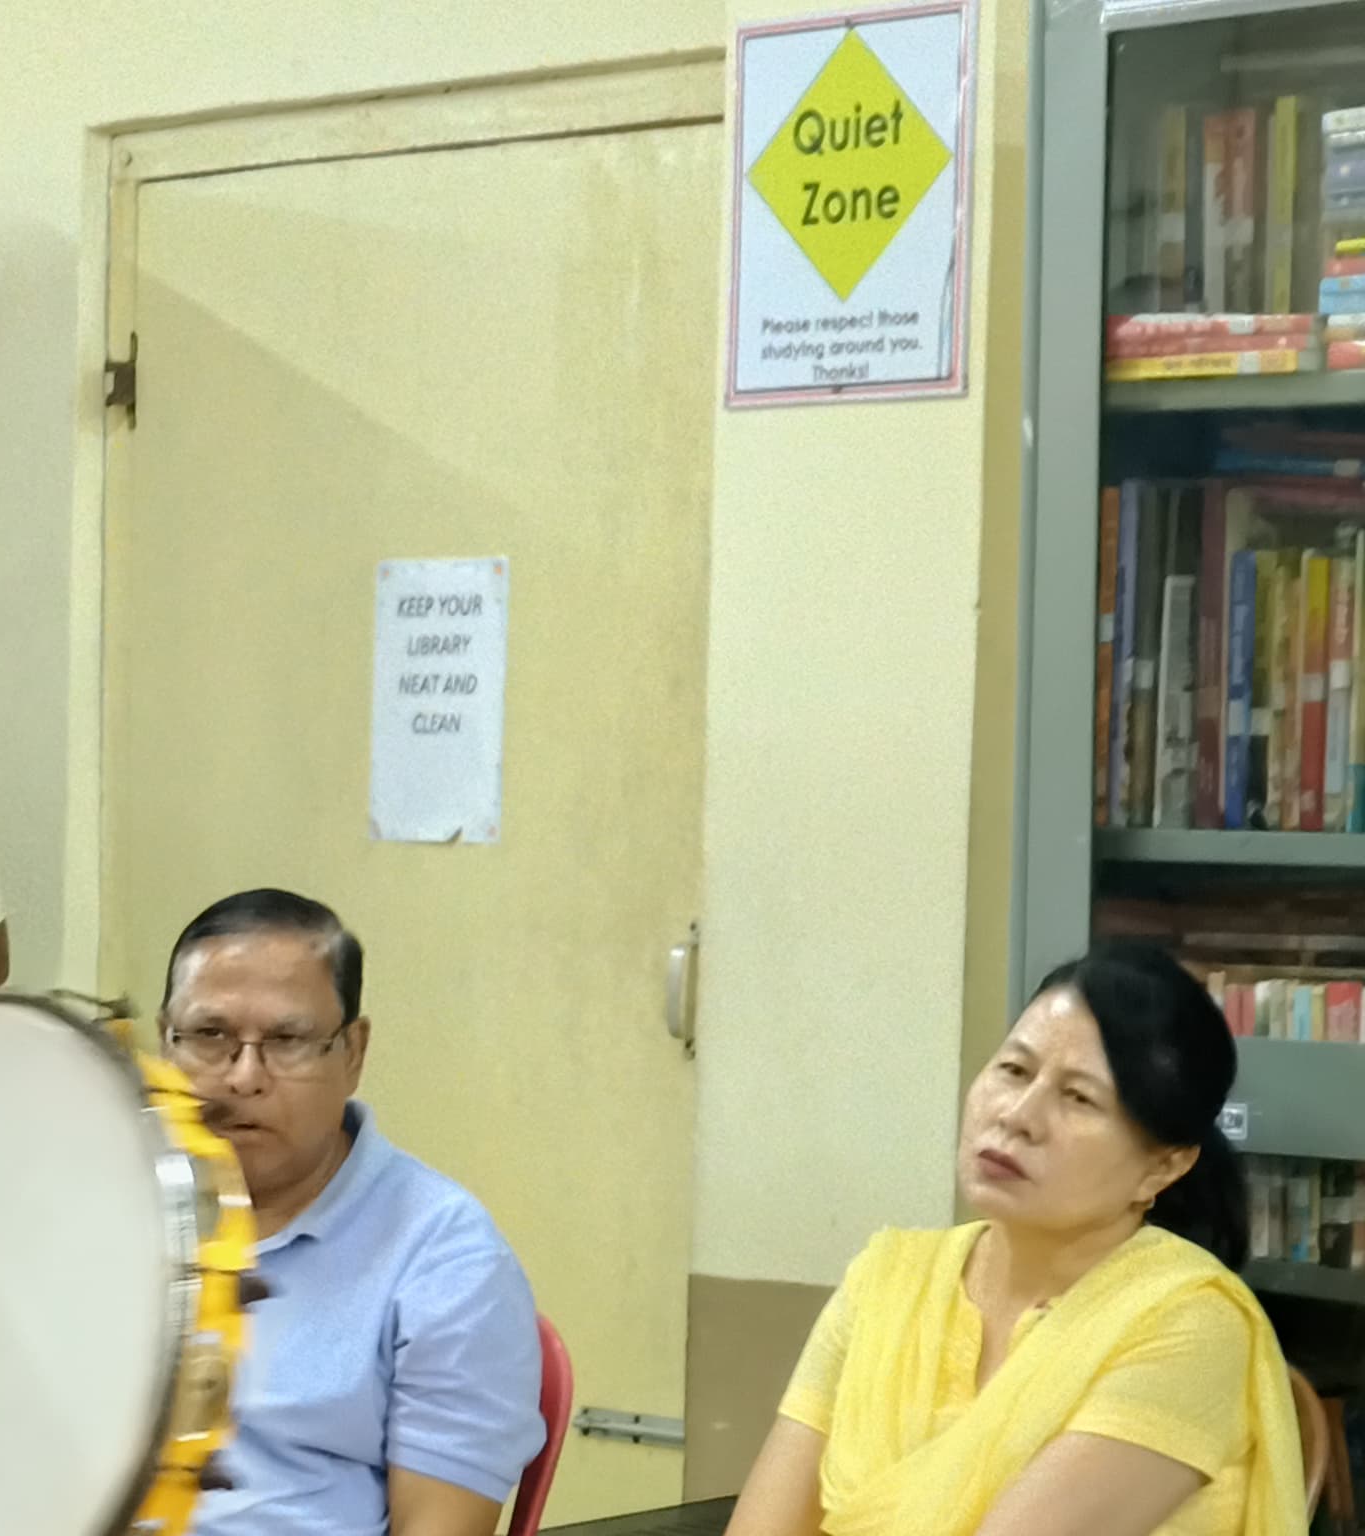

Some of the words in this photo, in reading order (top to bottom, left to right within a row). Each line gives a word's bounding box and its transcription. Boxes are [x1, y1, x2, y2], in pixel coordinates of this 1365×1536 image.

[793, 98, 903, 156] Quiet
[801, 181, 900, 226] Zone
[761, 317, 811, 335] Please
[815, 310, 874, 332] respect
[877, 308, 920, 327] those
[761, 340, 825, 361] studying
[828, 336, 885, 355] around
[888, 337, 923, 356] you.
[811, 360, 870, 382] Thanks!
[397, 595, 434, 618] KEEP
[438, 593, 483, 617] YOUR
[406, 633, 472, 656] LIBRARY
[398, 673, 440, 695] NEAT
[443, 673, 478, 695] AND
[412, 711, 462, 734] CLEAN
